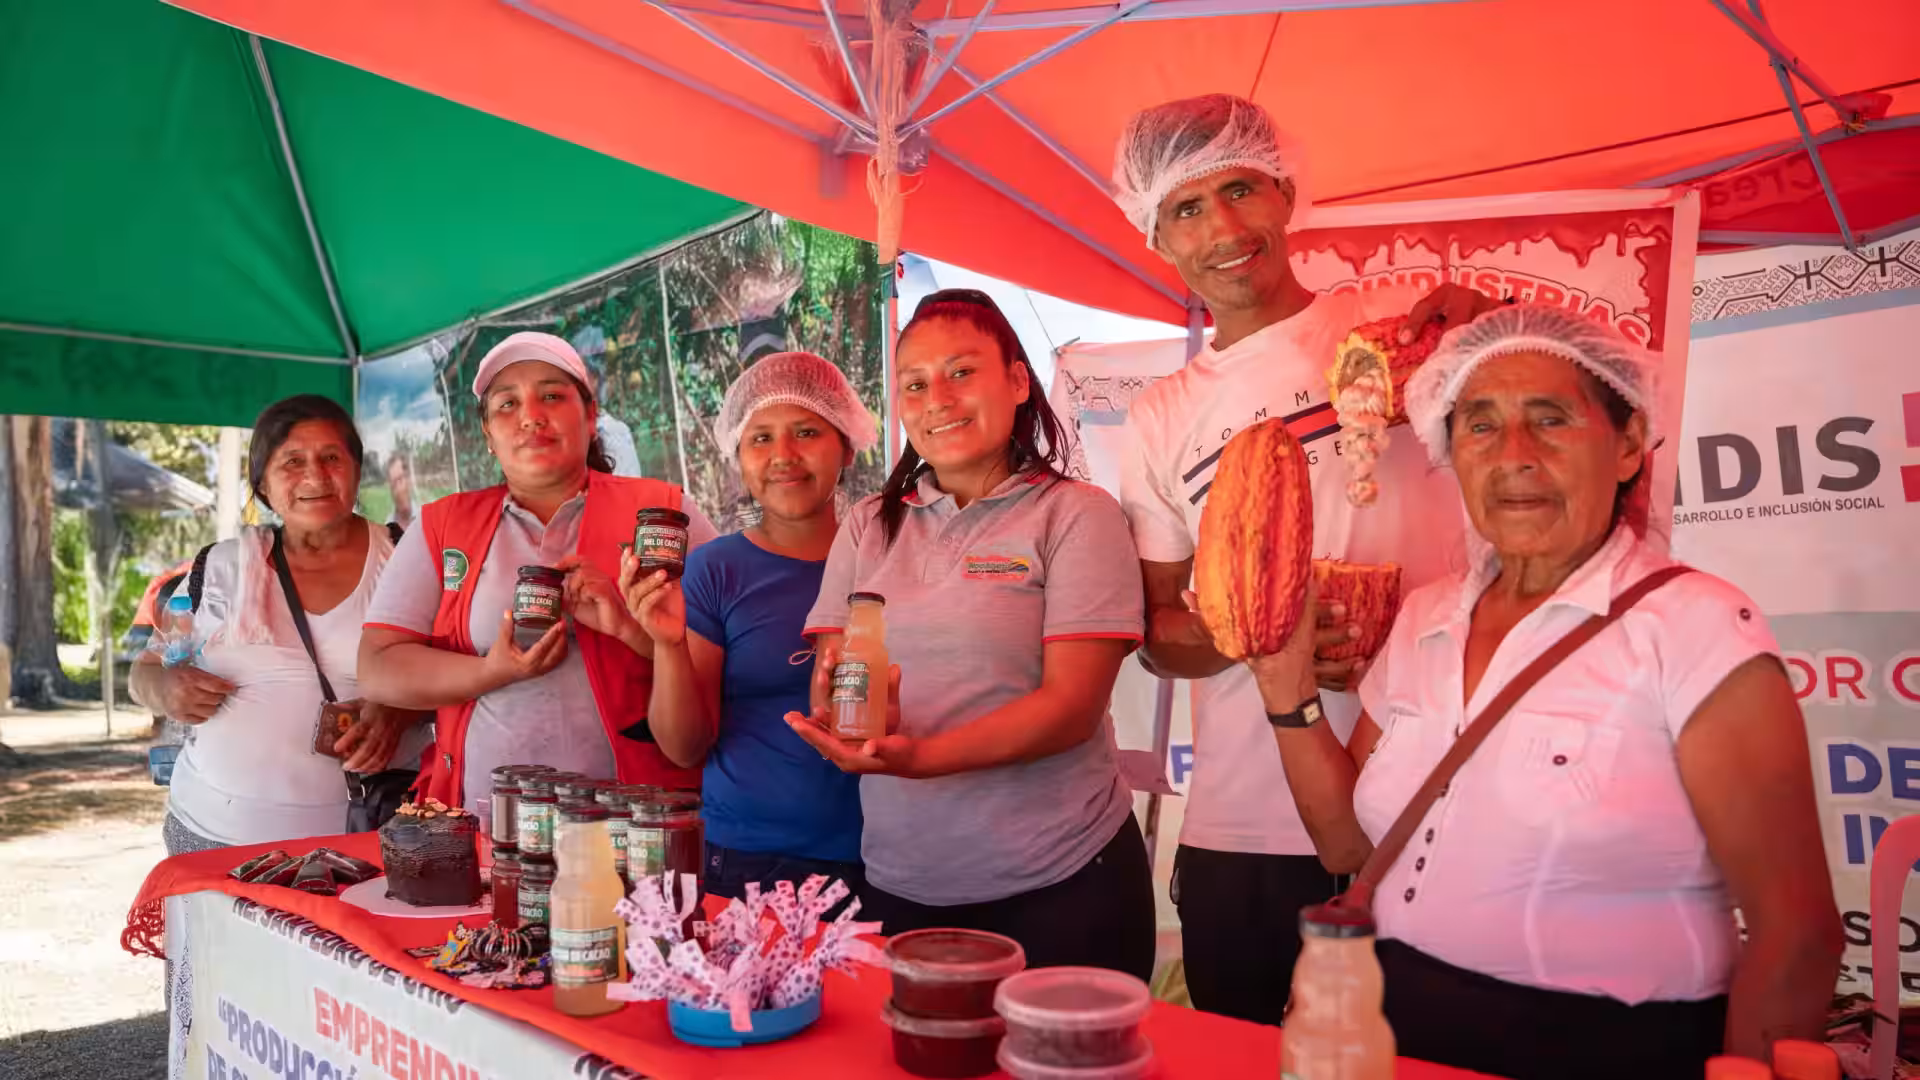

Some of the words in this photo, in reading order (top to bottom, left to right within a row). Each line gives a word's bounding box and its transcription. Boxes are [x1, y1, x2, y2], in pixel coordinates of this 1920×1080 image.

[1747, 507, 1756, 518] E
[1759, 499, 1831, 517] INCLUSIÓN
[1835, 497, 1885, 512] SOCIAL
[313, 986, 480, 1080] EMPREND
